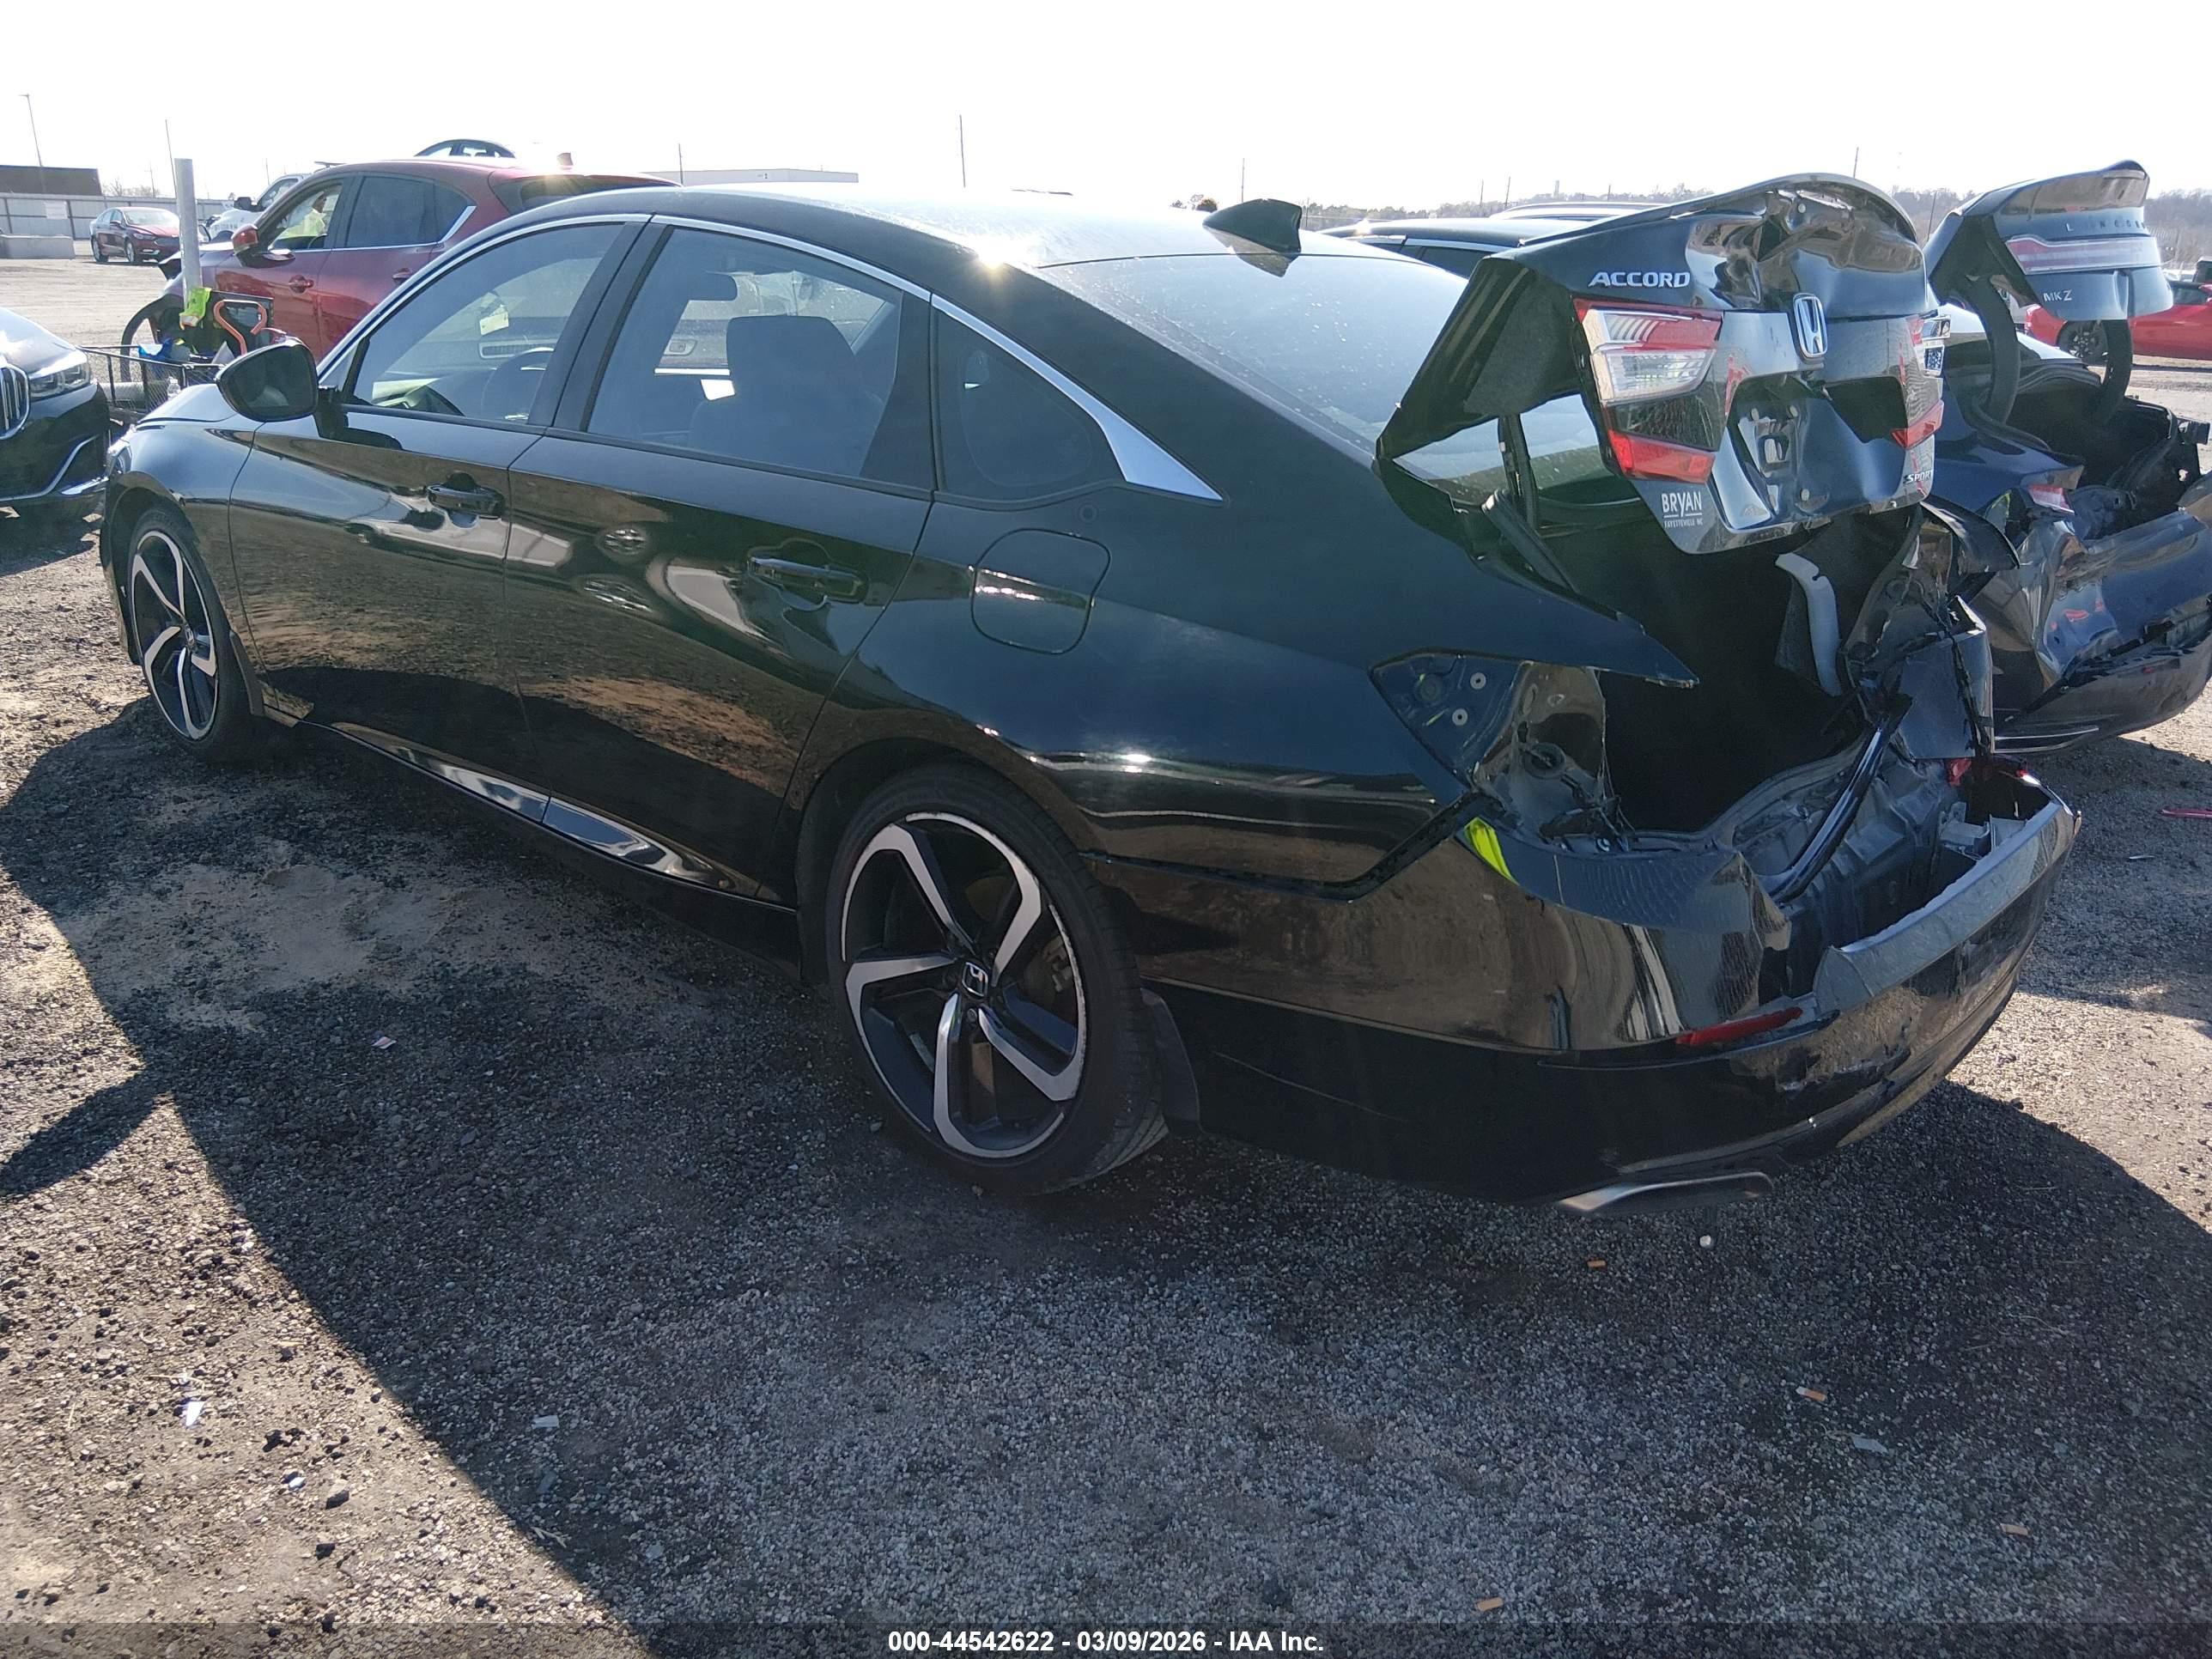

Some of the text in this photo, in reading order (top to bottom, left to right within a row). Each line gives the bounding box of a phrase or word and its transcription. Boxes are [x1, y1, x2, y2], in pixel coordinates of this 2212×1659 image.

[1588, 271, 1691, 288] ACCORD
[2043, 289, 2072, 301] MKZ
[1662, 491, 1702, 517] BRYAN
